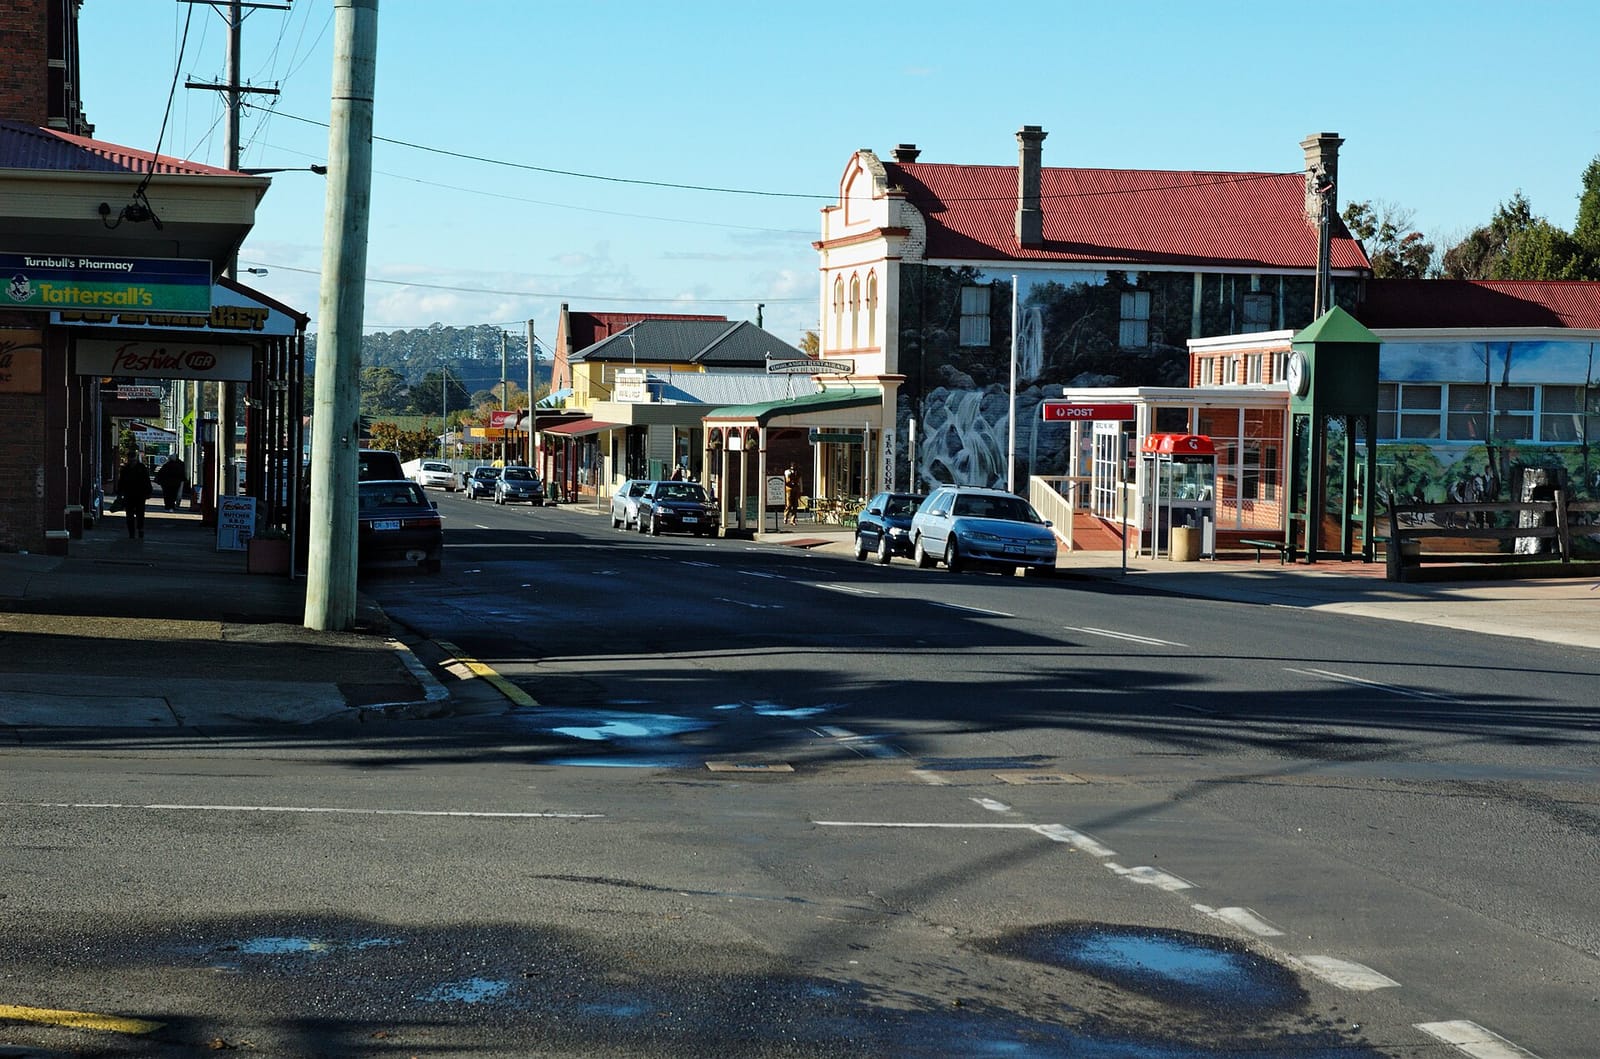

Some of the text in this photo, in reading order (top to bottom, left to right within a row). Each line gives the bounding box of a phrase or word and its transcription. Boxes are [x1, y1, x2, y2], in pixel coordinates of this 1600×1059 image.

[24, 256, 134, 272] Turnbull's Pharmacy
[39, 284, 153, 306] Tattersall's
[112, 343, 212, 373] Festival IGA
[1067, 408, 1094, 417] POST
